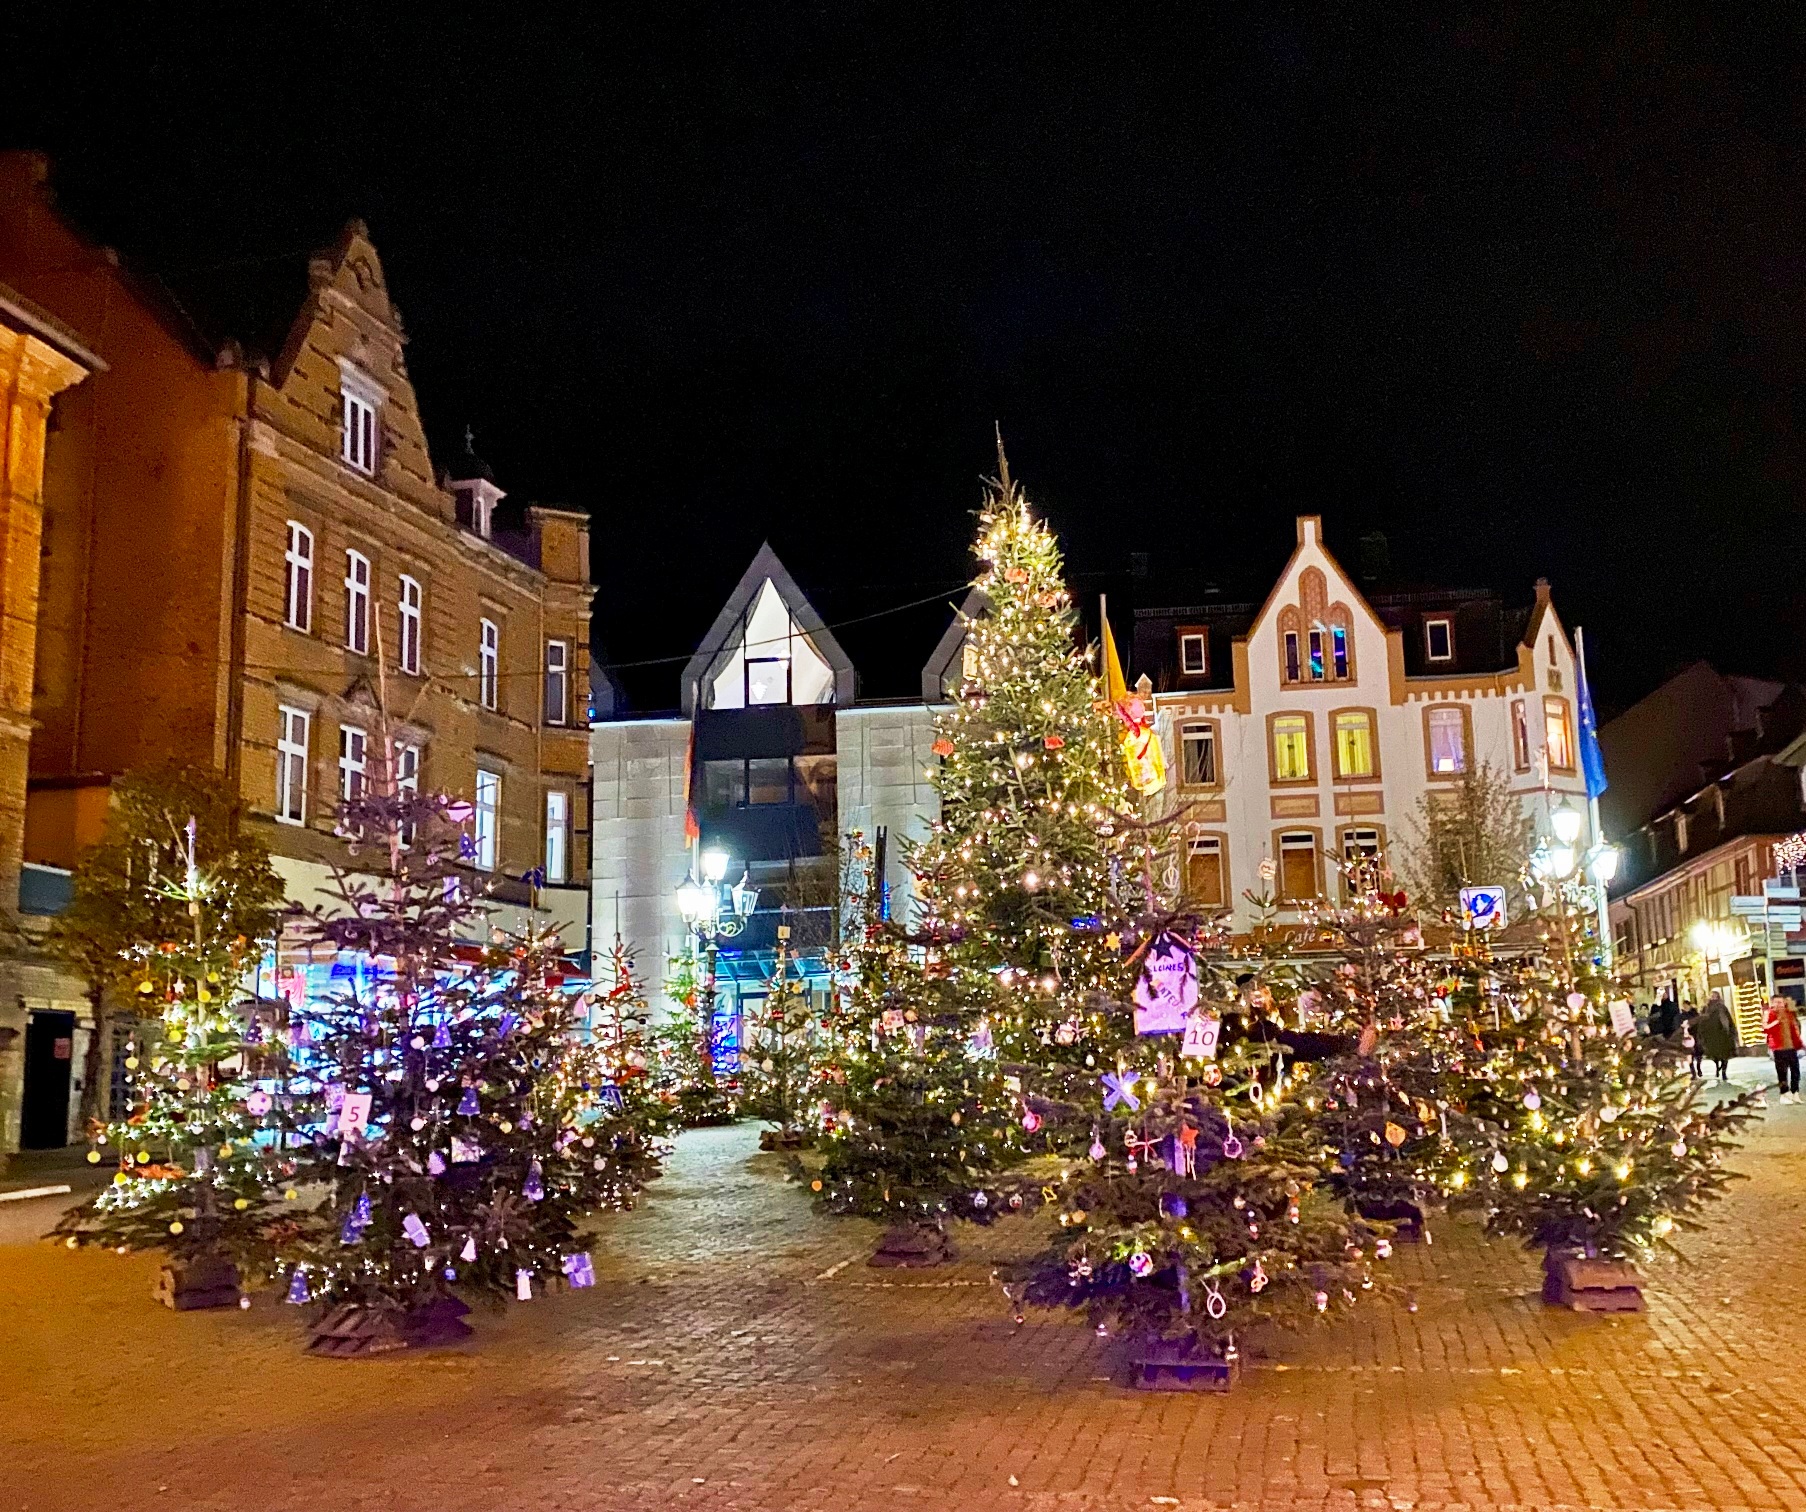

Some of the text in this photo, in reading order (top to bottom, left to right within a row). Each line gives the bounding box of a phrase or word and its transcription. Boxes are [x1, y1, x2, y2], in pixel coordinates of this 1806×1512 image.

[1284, 926, 1316, 948] Café
[1188, 1030, 1215, 1047] 10
[348, 1106, 361, 1123] 5
